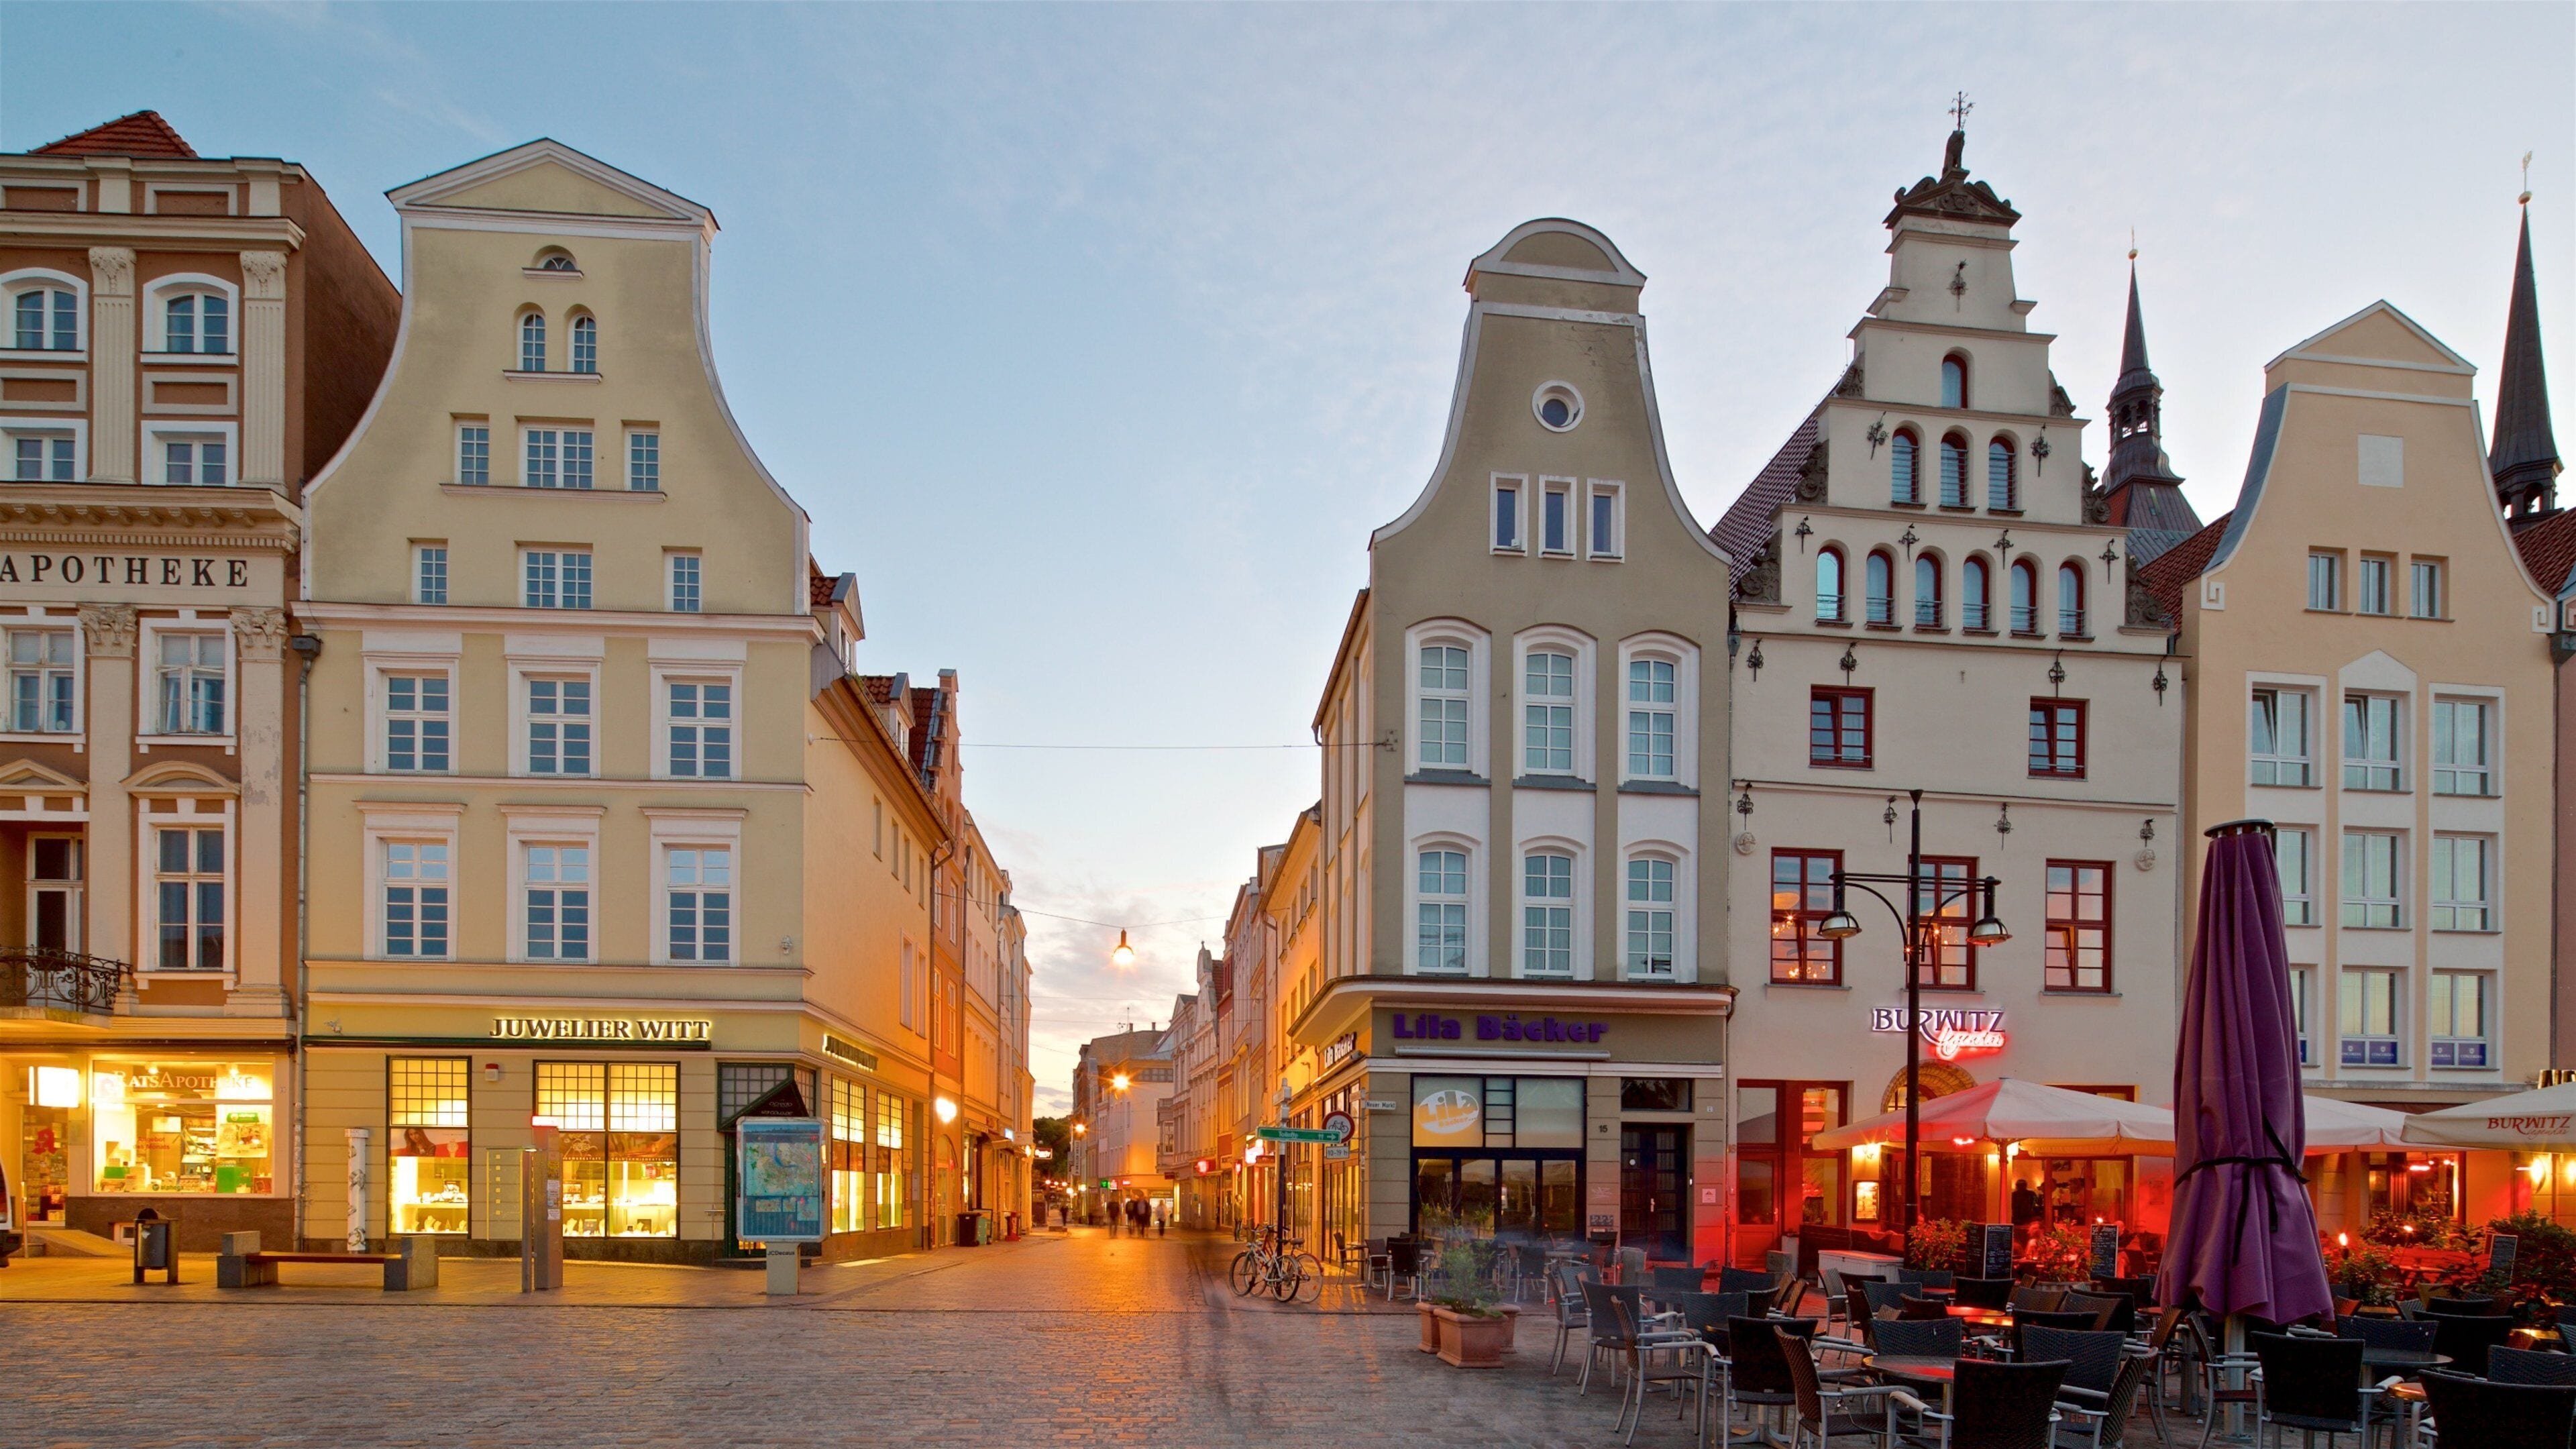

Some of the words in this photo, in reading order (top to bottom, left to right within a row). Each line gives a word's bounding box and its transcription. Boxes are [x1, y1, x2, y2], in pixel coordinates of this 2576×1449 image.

[0, 555, 248, 588] APOTHEKE
[490, 1018, 630, 1038] JUWELIER
[637, 1020, 710, 1038] WITT
[1393, 1013, 1461, 1039] Lila
[1477, 1014, 1609, 1042] Bäcker
[2487, 1116, 2571, 1135] BURWITZ
